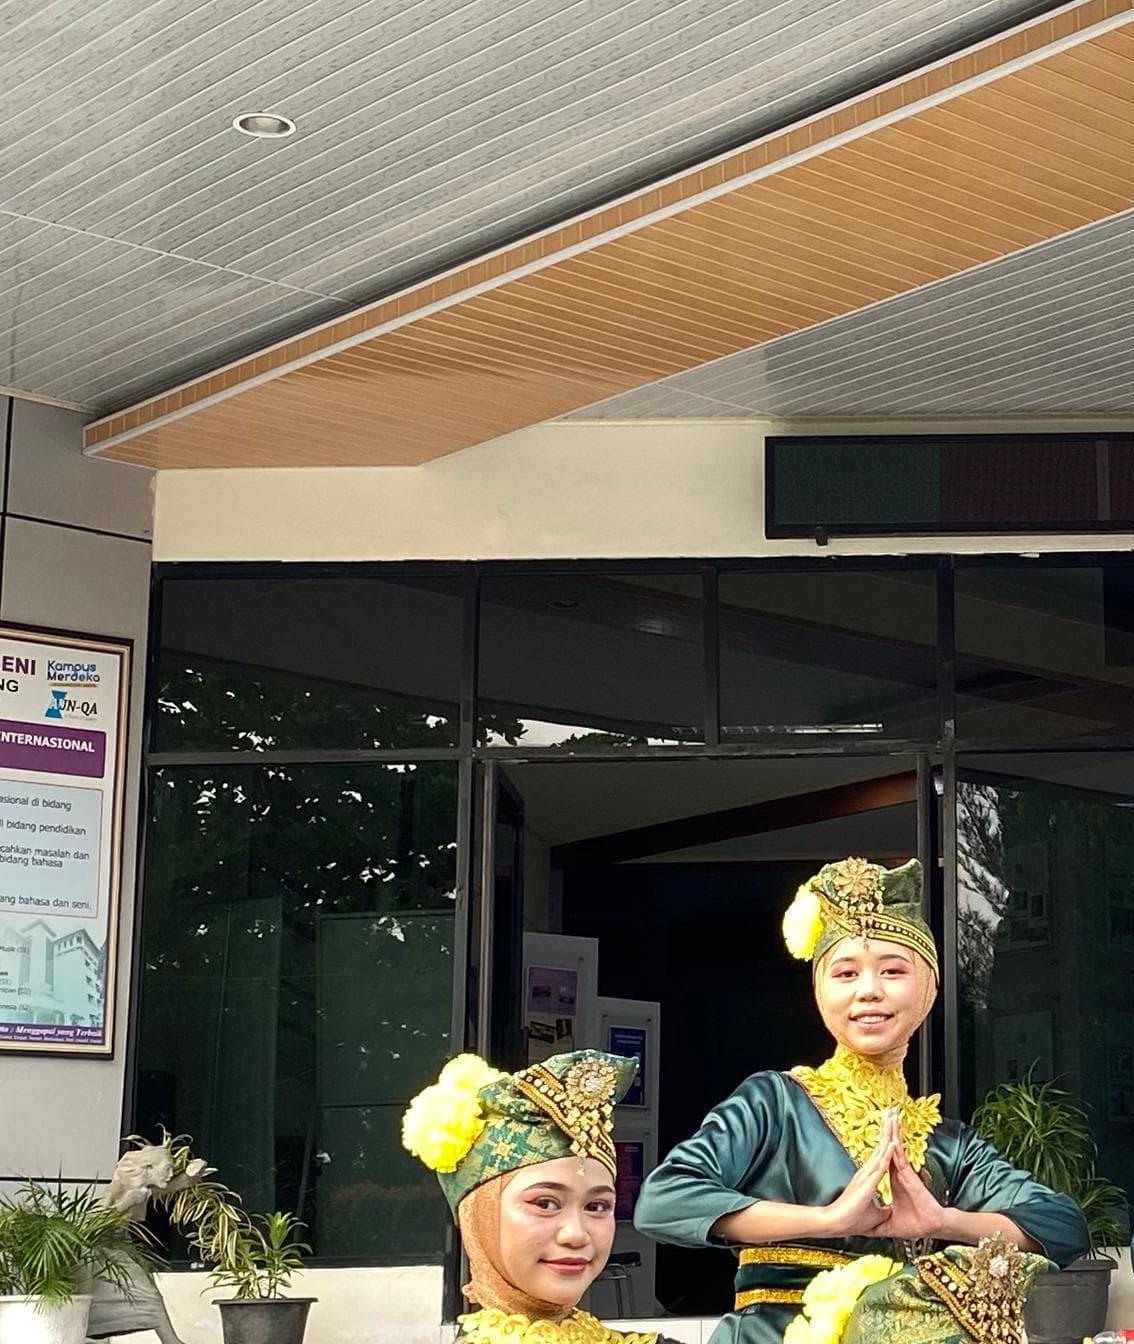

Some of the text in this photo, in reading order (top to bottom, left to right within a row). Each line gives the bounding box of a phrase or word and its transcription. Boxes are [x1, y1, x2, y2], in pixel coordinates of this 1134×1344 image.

[0, 655, 36, 676] ENI
[47, 660, 97, 674] Kampus
[47, 671, 101, 682] Merdeka
[42, 799, 72, 812] bidang
[6, 820, 36, 832] bidang
[39, 824, 87, 835] pendidikan
[34, 848, 71, 859] masalah
[73, 850, 90, 860] dan
[32, 857, 63, 868] bahasa
[18, 896, 50, 907] bahasa
[52, 898, 69, 908] dan
